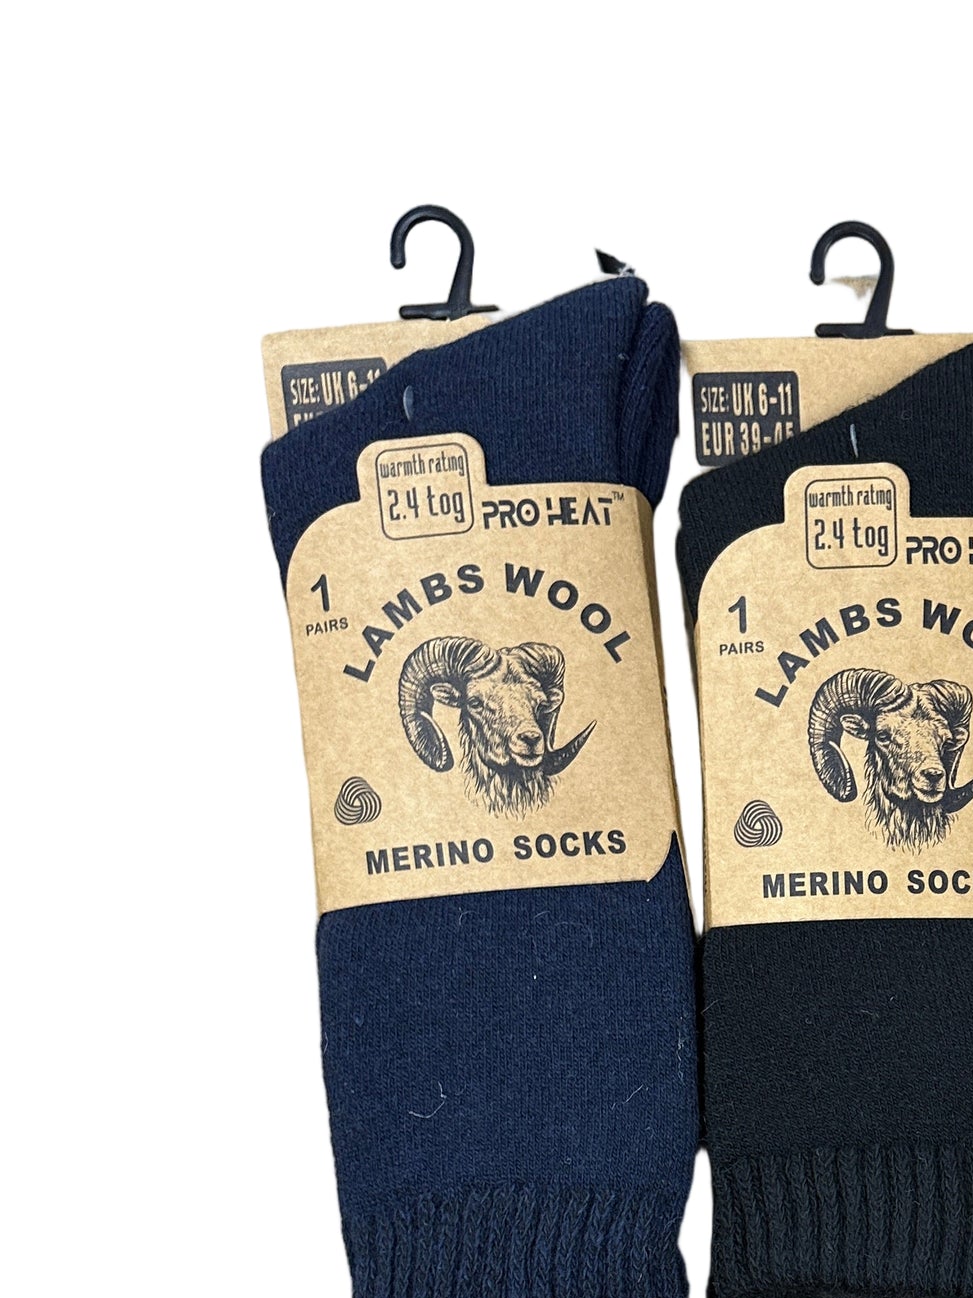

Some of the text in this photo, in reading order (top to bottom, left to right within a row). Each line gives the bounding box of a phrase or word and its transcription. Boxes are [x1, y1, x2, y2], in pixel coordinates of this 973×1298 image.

[290, 377, 320, 405] SIZE:
[321, 371, 345, 406] UK
[701, 382, 792, 416] SIZE: UK 6-11
[702, 421, 735, 456] EUR
[380, 451, 464, 478] warmth rating
[387, 485, 465, 523] 2.4 tog
[809, 484, 892, 511] warmth rating
[814, 517, 889, 557] 2.4 tog
[310, 574, 330, 612] 1
[305, 617, 349, 636] PAIRS
[343, 563, 631, 683] LAMBS WOOL
[728, 595, 747, 634] 1
[719, 640, 764, 656] PAIRS
[755, 598, 903, 708] LAMBS
[365, 829, 627, 875] MERINO SOCKS
[762, 869, 888, 899] MERINO
